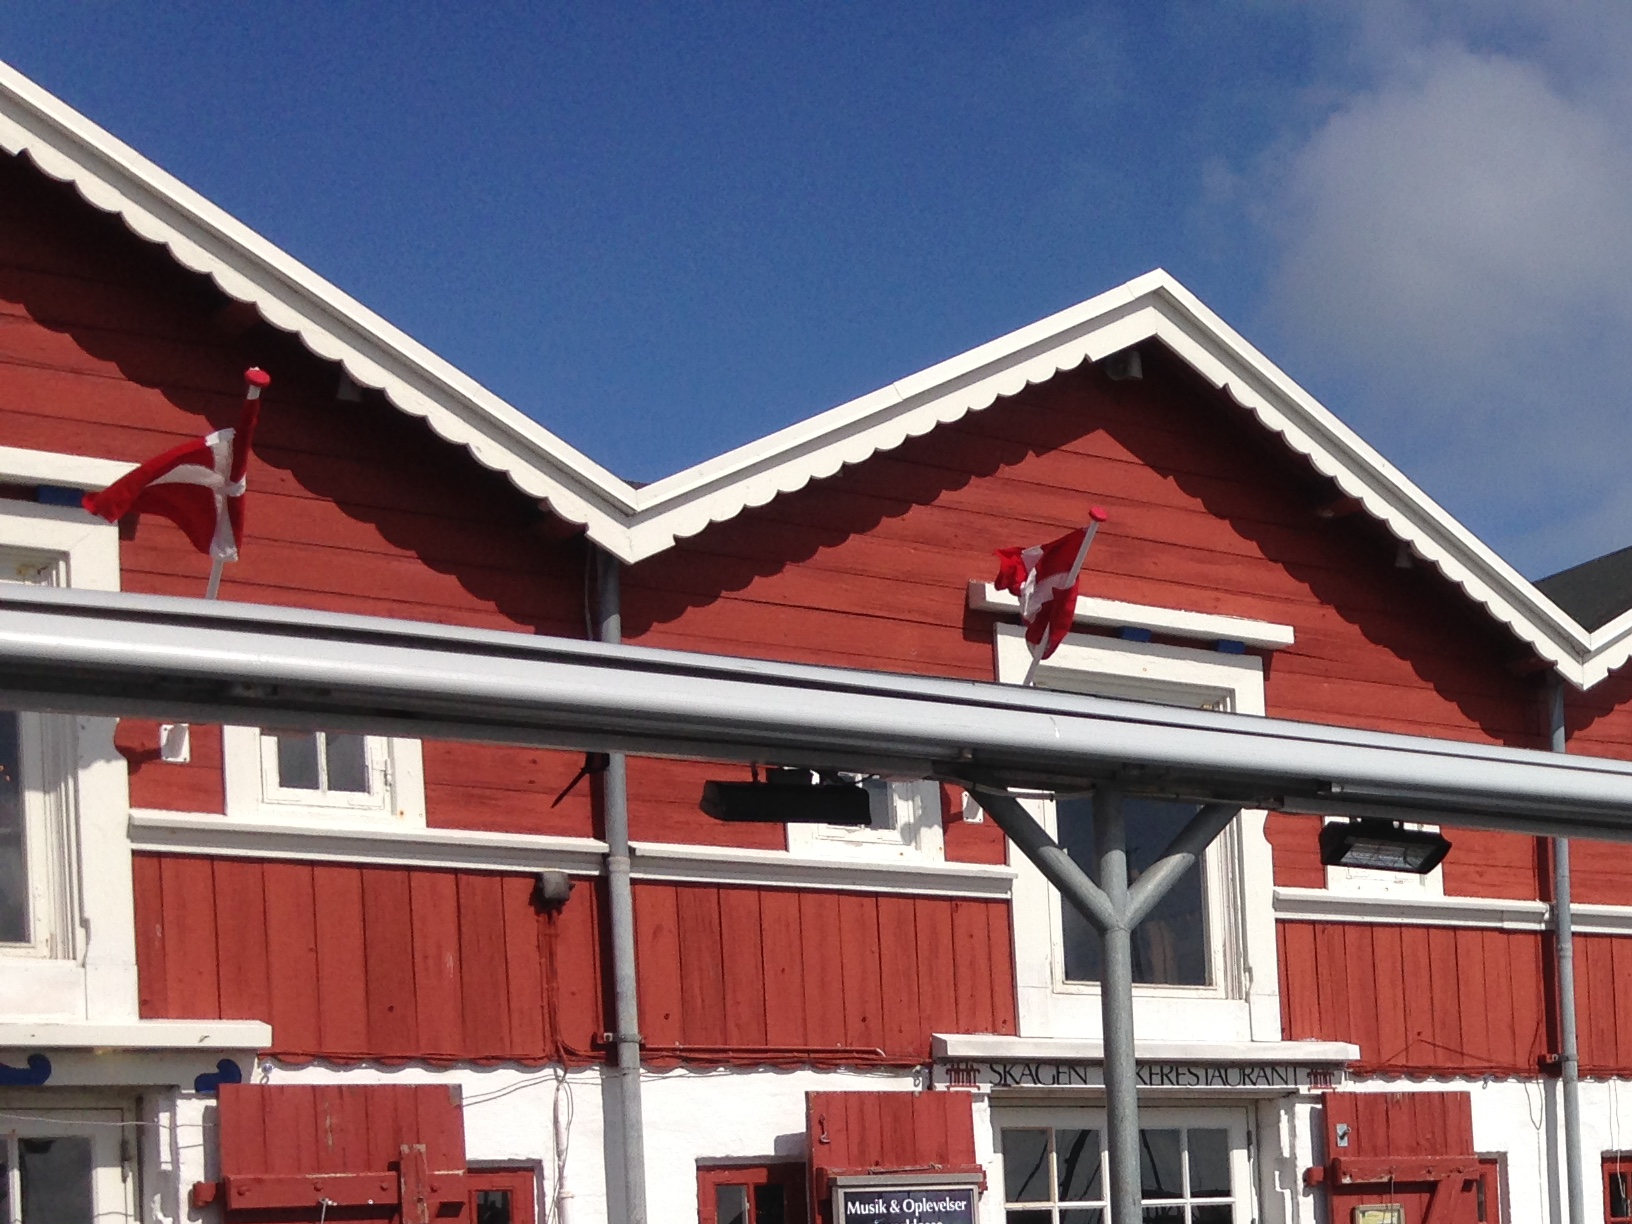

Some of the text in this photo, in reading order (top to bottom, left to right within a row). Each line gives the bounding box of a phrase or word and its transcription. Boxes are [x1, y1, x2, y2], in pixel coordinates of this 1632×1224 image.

[989, 1062, 1297, 1087] SKAGEN KERESTAURANT
[847, 1196, 967, 1216] Musik & Oplevelser
